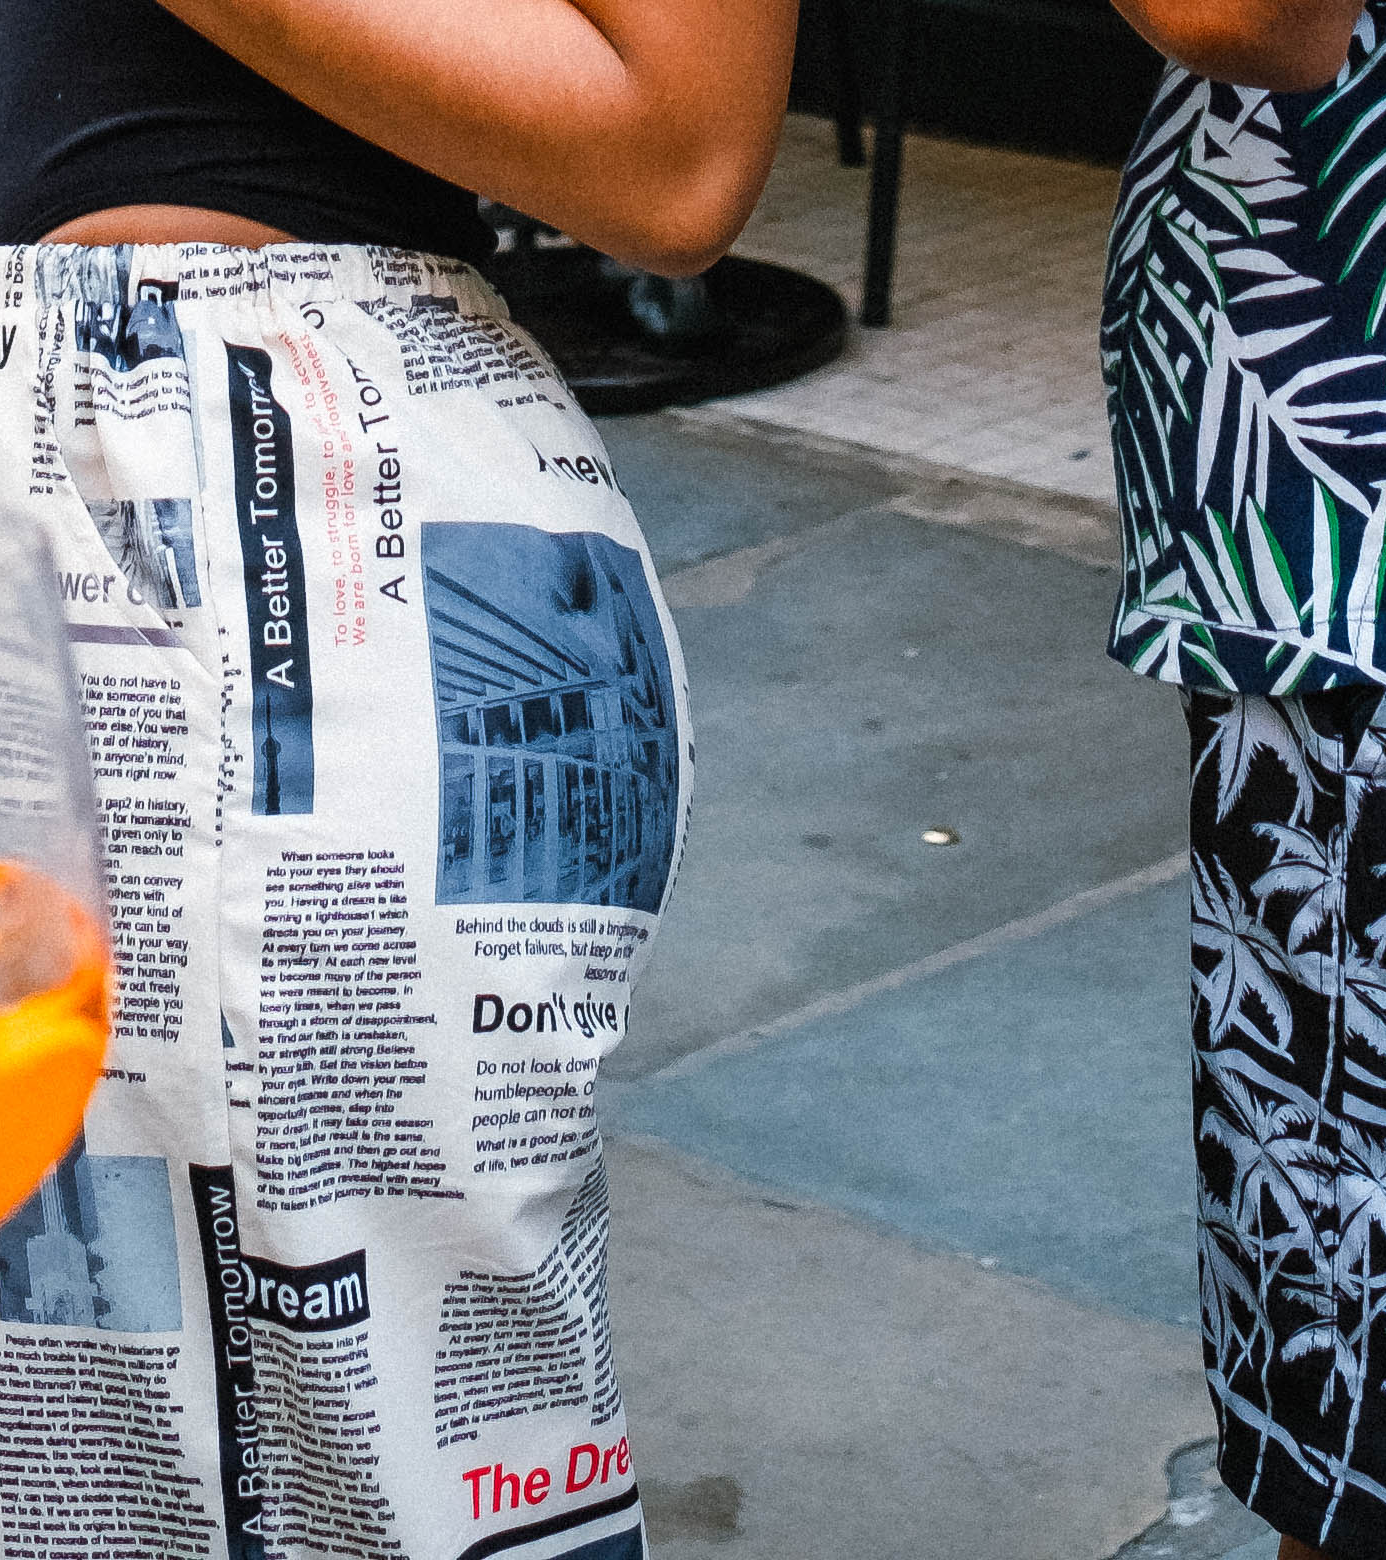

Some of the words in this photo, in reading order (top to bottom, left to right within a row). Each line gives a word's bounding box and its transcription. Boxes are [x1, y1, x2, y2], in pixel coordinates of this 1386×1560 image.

[342, 459, 354, 494] love
[372, 442, 405, 559] Better
[345, 500, 356, 531] for
[350, 534, 362, 574] born
[261, 534, 292, 647] Better
[355, 581, 366, 613] are
[379, 574, 408, 604] A
[334, 624, 348, 648] To
[352, 618, 366, 646] We
[81, 673, 99, 686] You
[103, 675, 116, 686] do
[120, 676, 138, 688] not
[141, 676, 166, 689] have
[171, 678, 181, 690] to
[266, 659, 295, 688] A
[86, 689, 103, 699] like
[107, 691, 155, 703] someone
[130, 705, 140, 717] of
[143, 708, 162, 720] you
[166, 708, 186, 720] that
[160, 726, 188, 735] were
[119, 736, 129, 747] of
[135, 799, 144, 809] in
[113, 813, 127, 824] for
[112, 830, 141, 841] given
[144, 830, 168, 843] only
[172, 830, 182, 841] to
[109, 844, 127, 854] can
[132, 844, 162, 855] reach
[165, 845, 183, 857] out
[121, 876, 140, 886] can
[144, 877, 183, 889] convey
[144, 890, 165, 902] with
[121, 906, 143, 918] your
[147, 905, 168, 918] kind
[172, 906, 184, 918] of
[135, 923, 153, 933] can
[455, 918, 503, 934] Behind
[508, 919, 526, 932] the
[530, 917, 564, 933] clouds
[568, 917, 577, 932] is
[580, 917, 597, 932] still
[139, 939, 163, 950] your
[474, 940, 521, 960] Forget
[525, 938, 568, 958] failures,
[571, 940, 588, 957] but
[137, 953, 155, 963] can
[159, 953, 188, 968] bring
[138, 967, 175, 979] human
[129, 982, 146, 992] out
[149, 982, 180, 996] freely
[124, 997, 160, 1010] people
[163, 999, 183, 1010] you
[163, 1013, 183, 1024] you
[473, 992, 572, 1033] Don't
[573, 992, 618, 1038] give
[115, 1026, 133, 1038] you
[137, 1026, 147, 1037] to
[477, 1060, 496, 1076] Do
[502, 1059, 525, 1075] not
[531, 1058, 562, 1074] look
[566, 1057, 598, 1071] down
[472, 1110, 520, 1132] people
[524, 1108, 547, 1123] can
[551, 1107, 575, 1120] not
[476, 1139, 505, 1152] What
[530, 1134, 558, 1148] good
[209, 1186, 252, 1369] Tomorrow
[233, 1385, 261, 1498] Better
[462, 1463, 551, 1520] The
[565, 1436, 632, 1494] Dre
